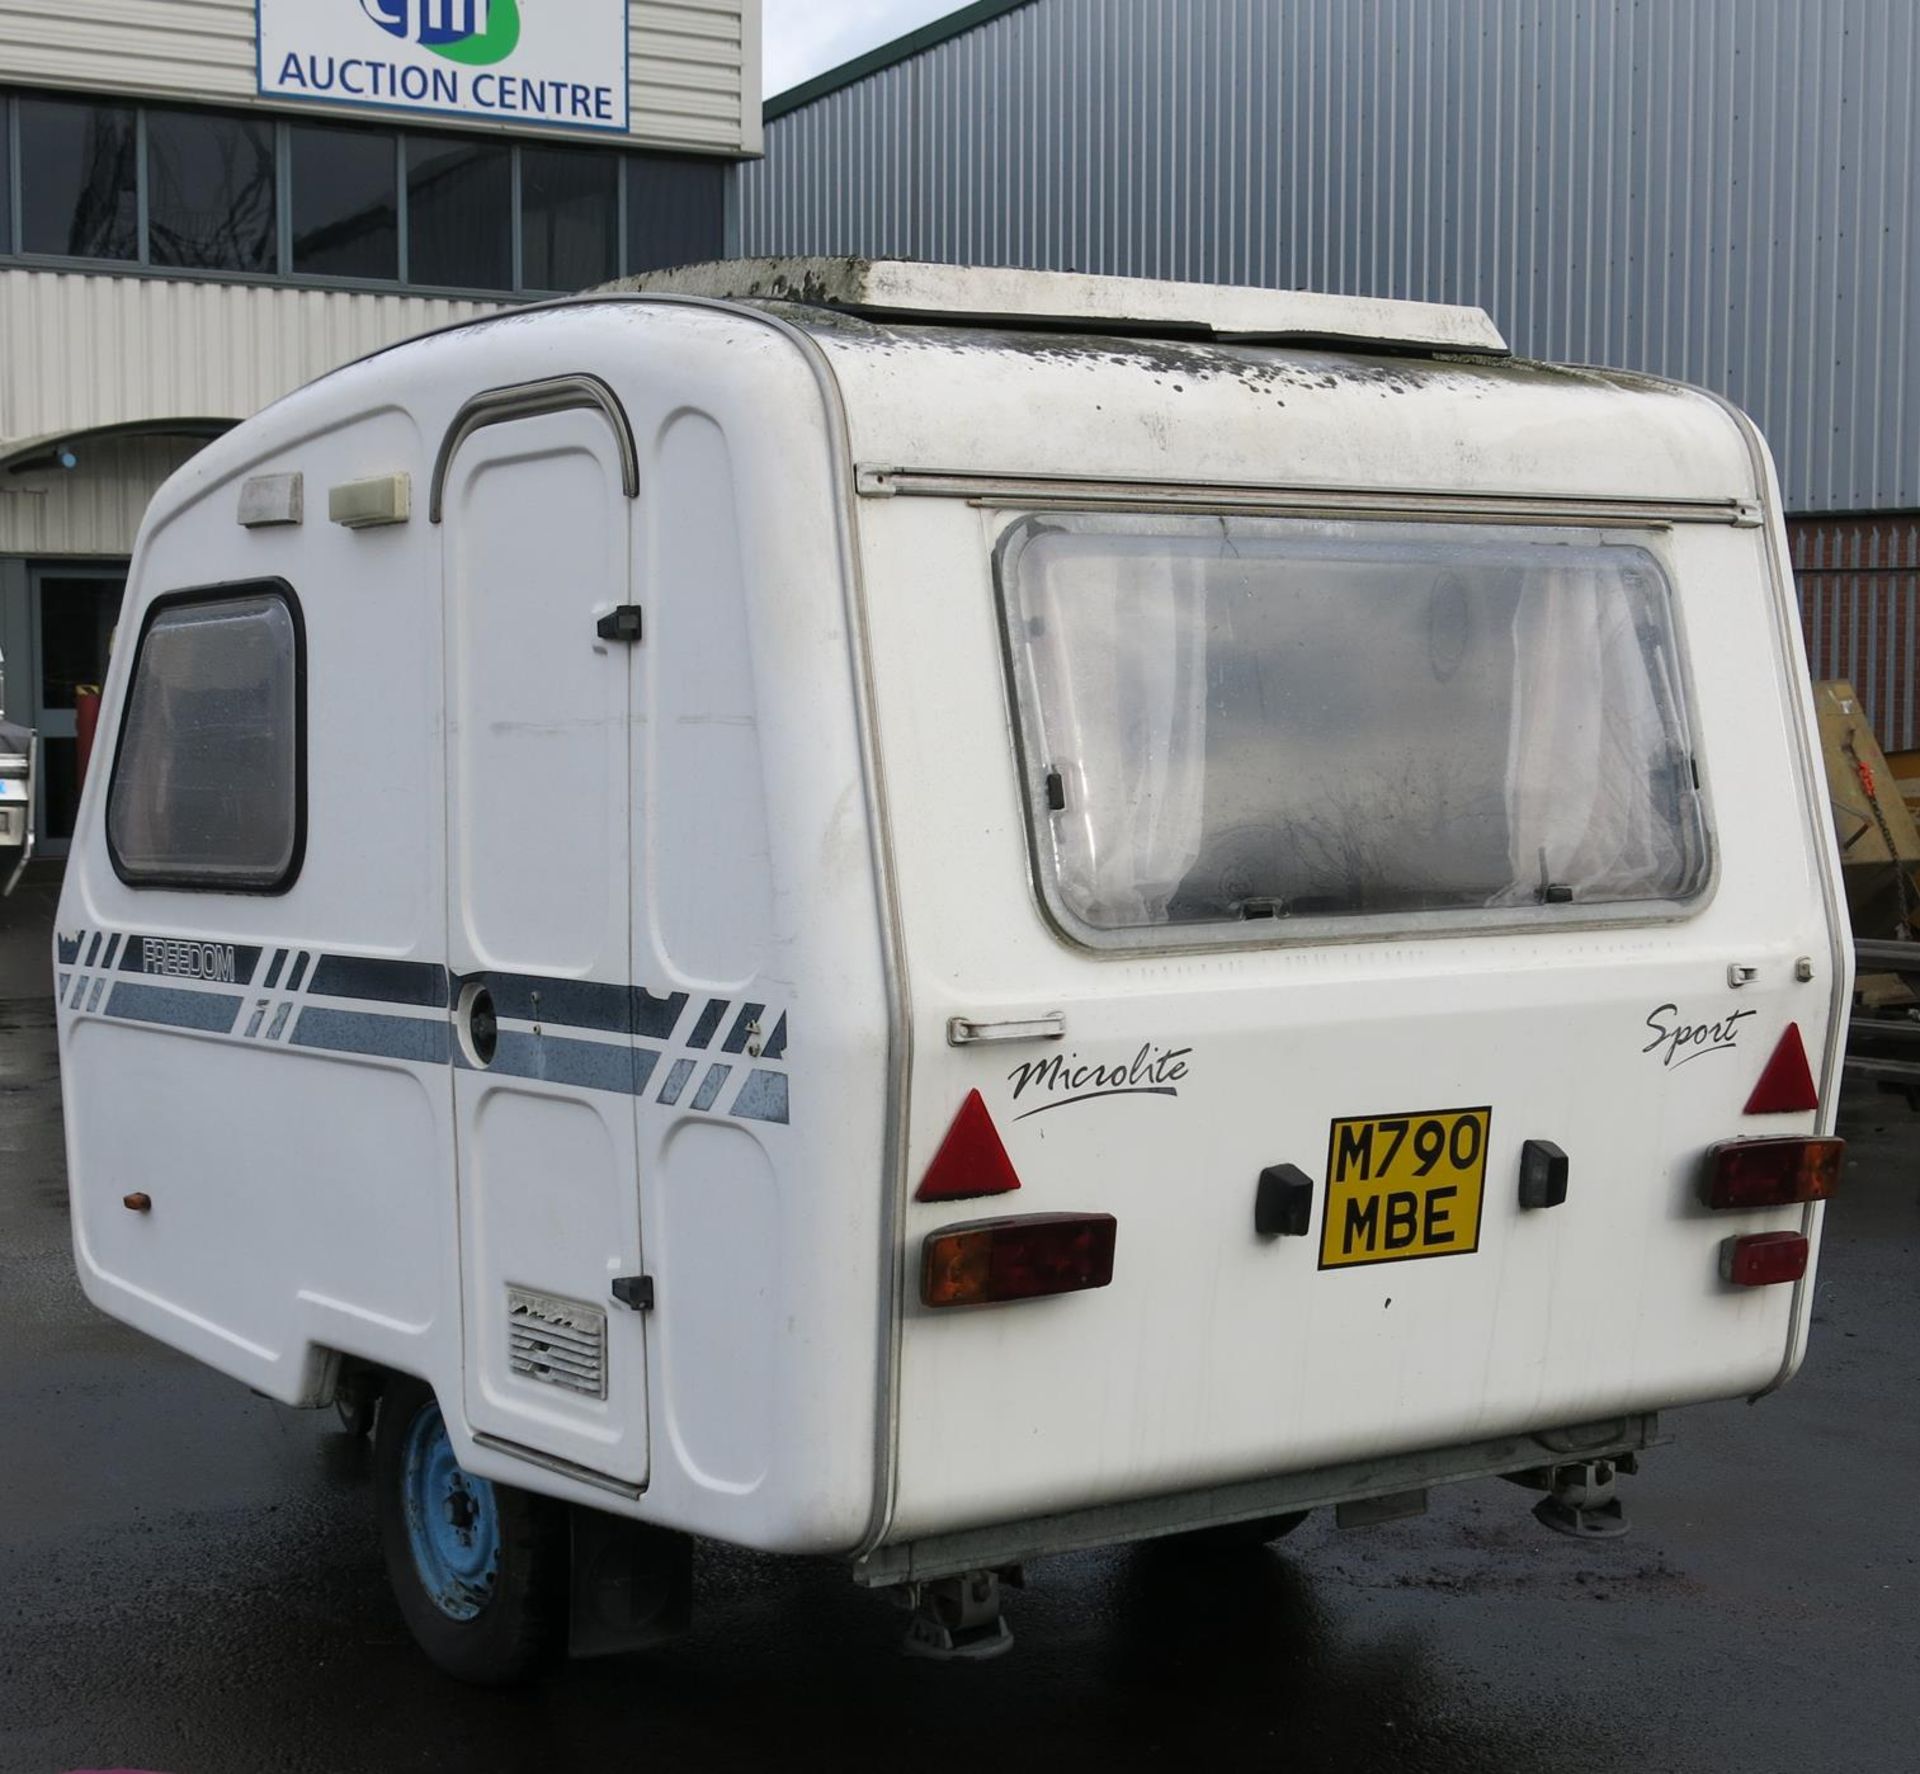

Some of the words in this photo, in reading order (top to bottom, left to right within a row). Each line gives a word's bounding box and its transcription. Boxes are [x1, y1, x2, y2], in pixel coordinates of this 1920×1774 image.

[278, 52, 458, 104] AUCTION
[471, 73, 613, 119] CENTRE
[142, 937, 236, 983] FREEDOM
[1642, 1003, 1757, 1066] Sport
[1008, 1042, 1193, 1100] Microlite
[1335, 1114, 1482, 1183] M790
[1342, 1185, 1458, 1255] MBE
